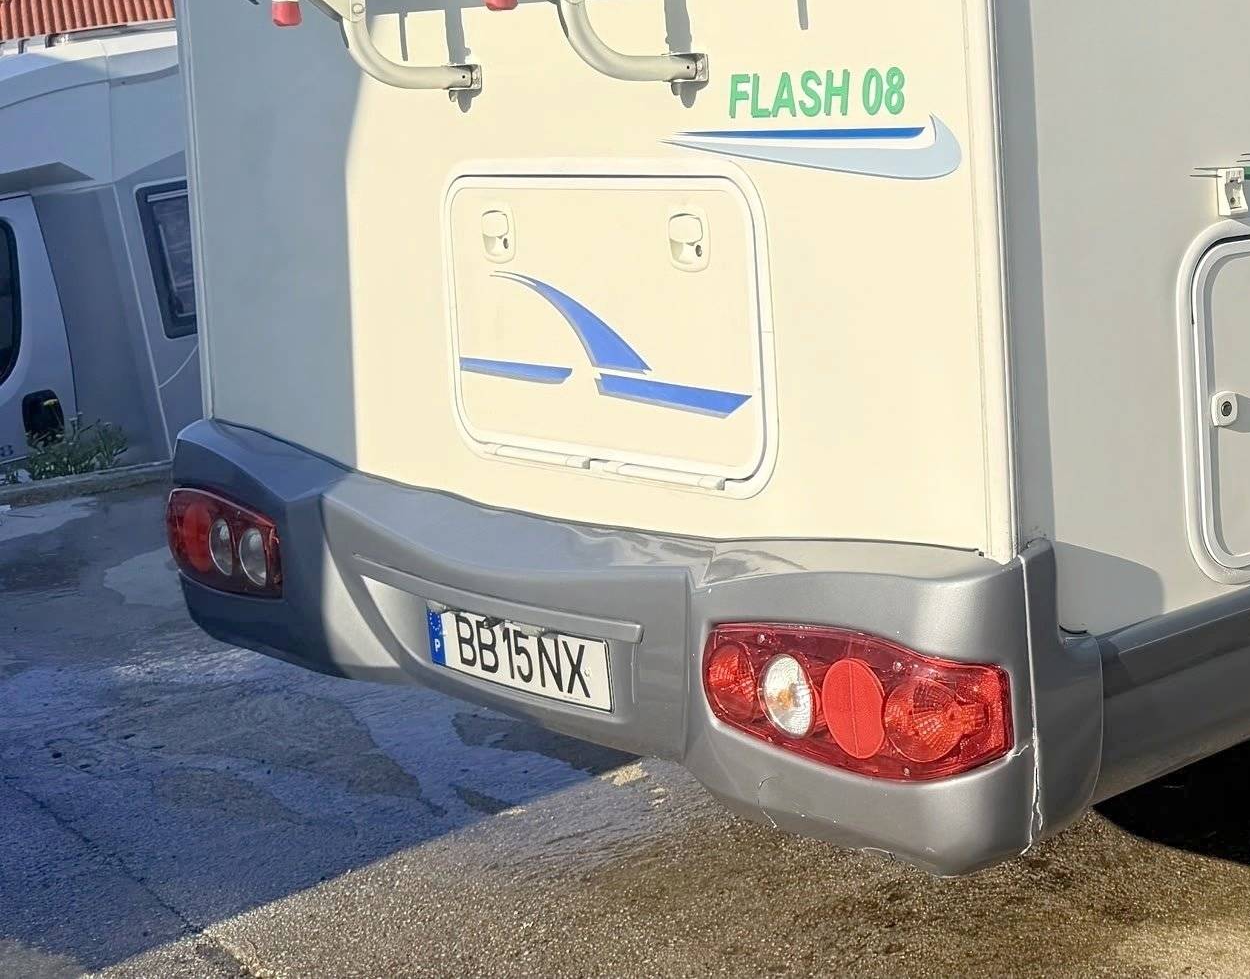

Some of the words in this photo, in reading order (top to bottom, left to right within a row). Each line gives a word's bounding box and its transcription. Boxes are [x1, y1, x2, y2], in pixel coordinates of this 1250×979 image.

[728, 68, 851, 119] FLASH
[862, 66, 906, 116] 08
[434, 638, 442, 653] P
